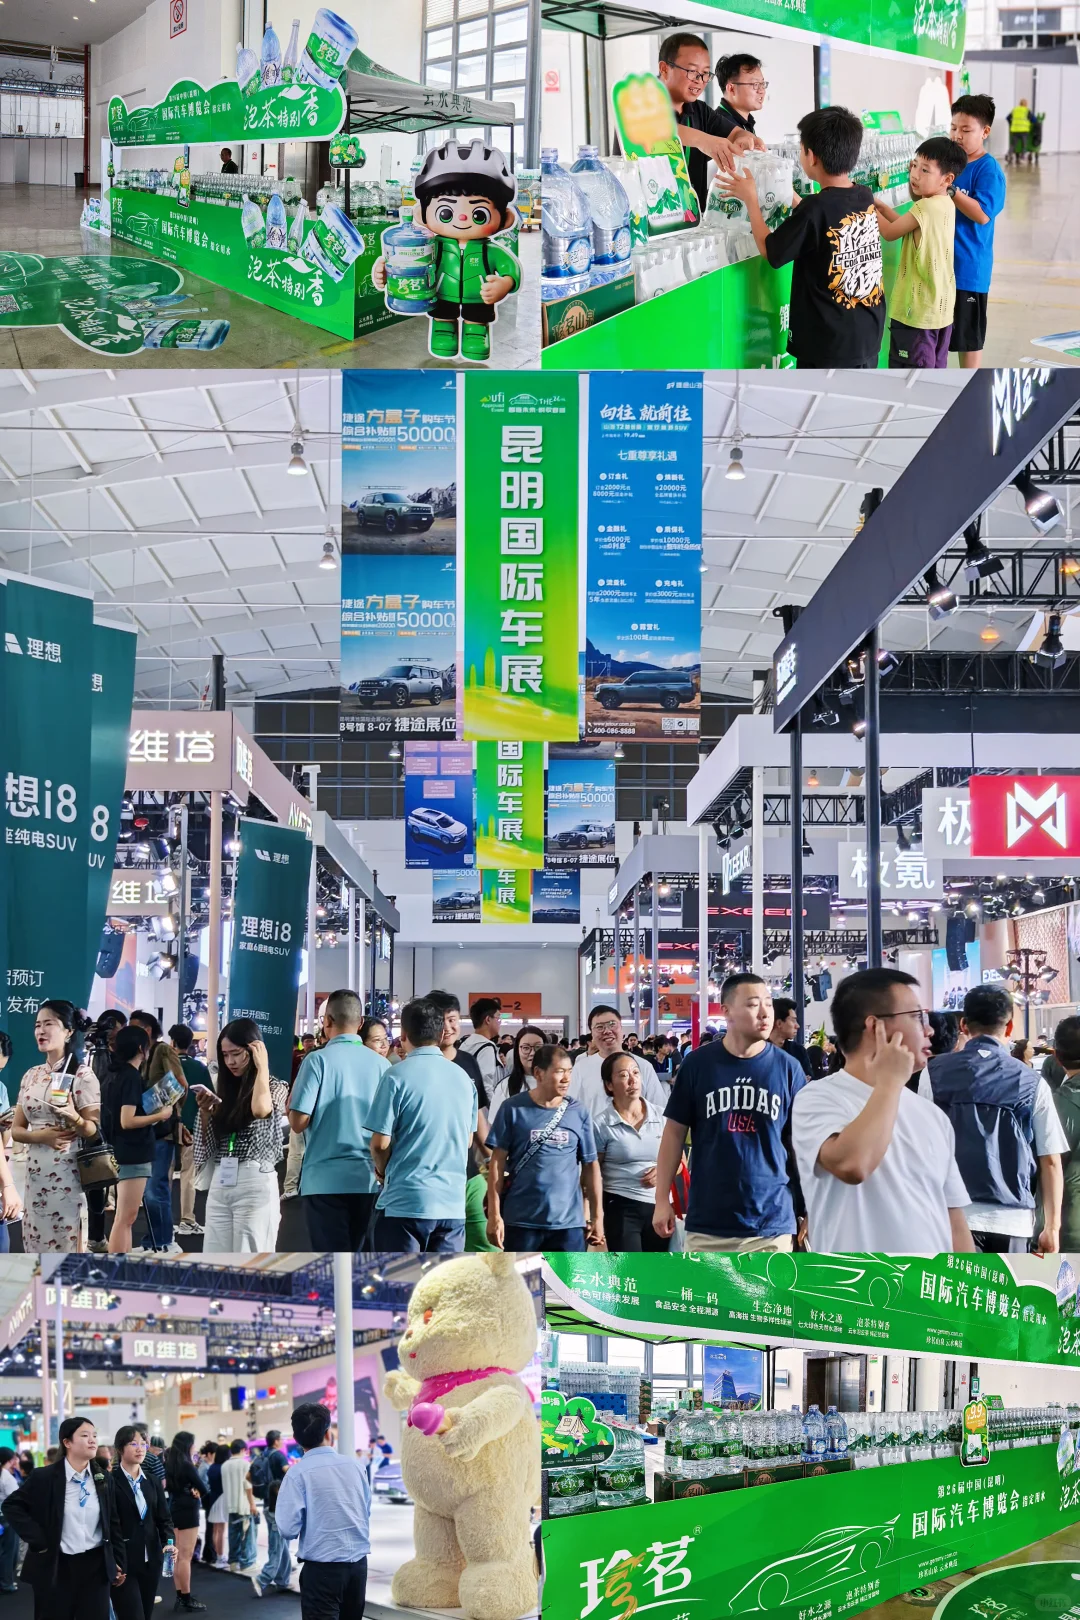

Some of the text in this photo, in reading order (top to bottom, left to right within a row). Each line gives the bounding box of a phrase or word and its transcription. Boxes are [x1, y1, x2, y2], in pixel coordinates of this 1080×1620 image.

[162, 100, 210, 120] 国际汽车博览会
[244, 86, 320, 130] 泡茶特别香
[422, 87, 472, 114] 云水典范
[161, 220, 209, 249] 国际汽车博览会
[247, 255, 325, 306] 泡茶特别香
[491, 391, 505, 403] ufi
[600, 402, 693, 424] 向往 就前往
[617, 450, 678, 462] 七重尊享礼遇
[500, 425, 544, 694] 昆明国际车展
[341, 594, 456, 610] 捷途方盒子购车节
[27, 636, 62, 664] 理想
[367, 722, 393, 732] 8-07
[394, 717, 457, 732] 捷途展位
[128, 729, 215, 763] 维塔
[497, 742, 523, 842] 国际车展
[272, 852, 290, 865] 理想
[578, 854, 616, 864] 捷途展位
[498, 869, 516, 904] 车展
[240, 915, 292, 943] 理想i8
[705, 1084, 781, 1122] ADIDAS
[571, 1272, 639, 1294] 云水典范
[654, 1300, 687, 1313] 食品安全
[920, 1270, 1022, 1321] 国际汽车博览会
[751, 1300, 793, 1317] 生态净地
[809, 1309, 844, 1324] 好水之源
[856, 1317, 891, 1331] 泡茶特别香
[133, 1339, 198, 1360] 阿维塔
[911, 1489, 1021, 1540] 国际汽车博览会
[580, 1535, 695, 1619] 珍茗
